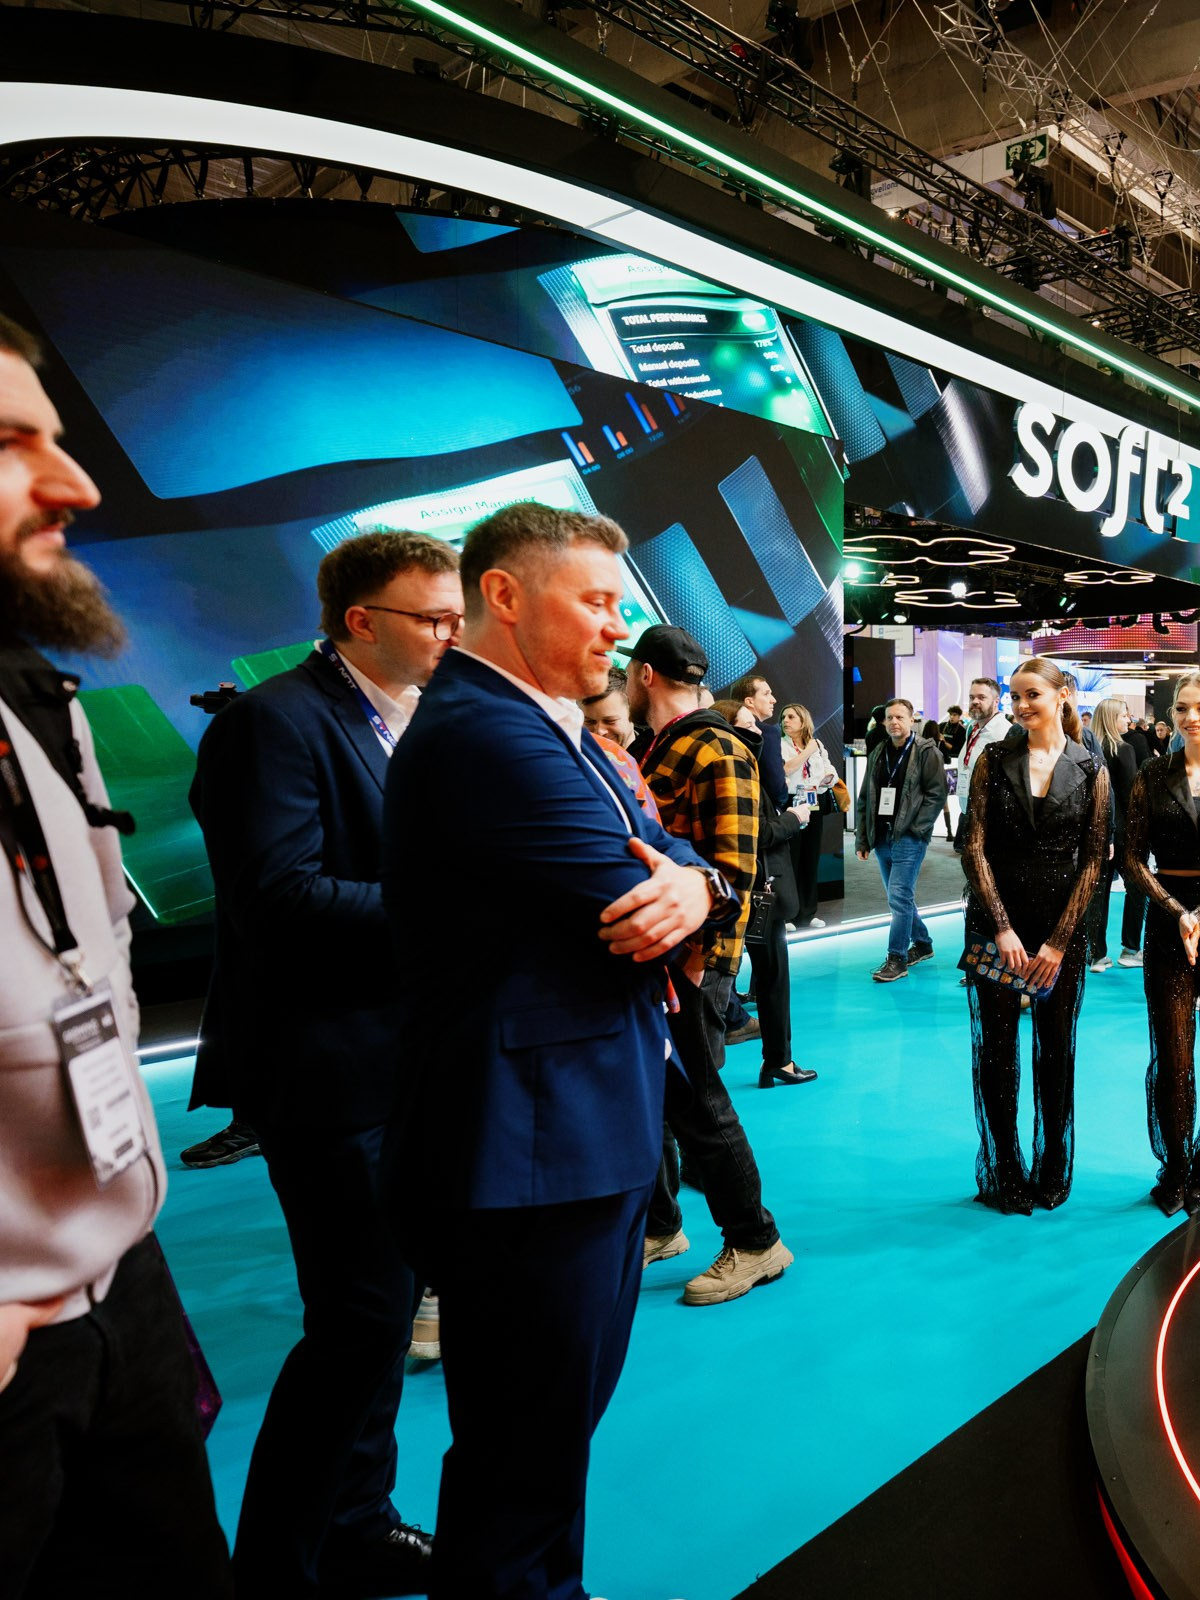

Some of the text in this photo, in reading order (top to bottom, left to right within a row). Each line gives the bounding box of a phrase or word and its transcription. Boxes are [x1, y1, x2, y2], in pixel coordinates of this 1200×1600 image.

[621, 312, 709, 326] TOTAL PERFORMANCE
[629, 343, 652, 354] Total
[651, 341, 686, 353] deposits
[668, 358, 700, 370] deposits
[645, 378, 668, 388] Total
[420, 505, 473, 520] Assign
